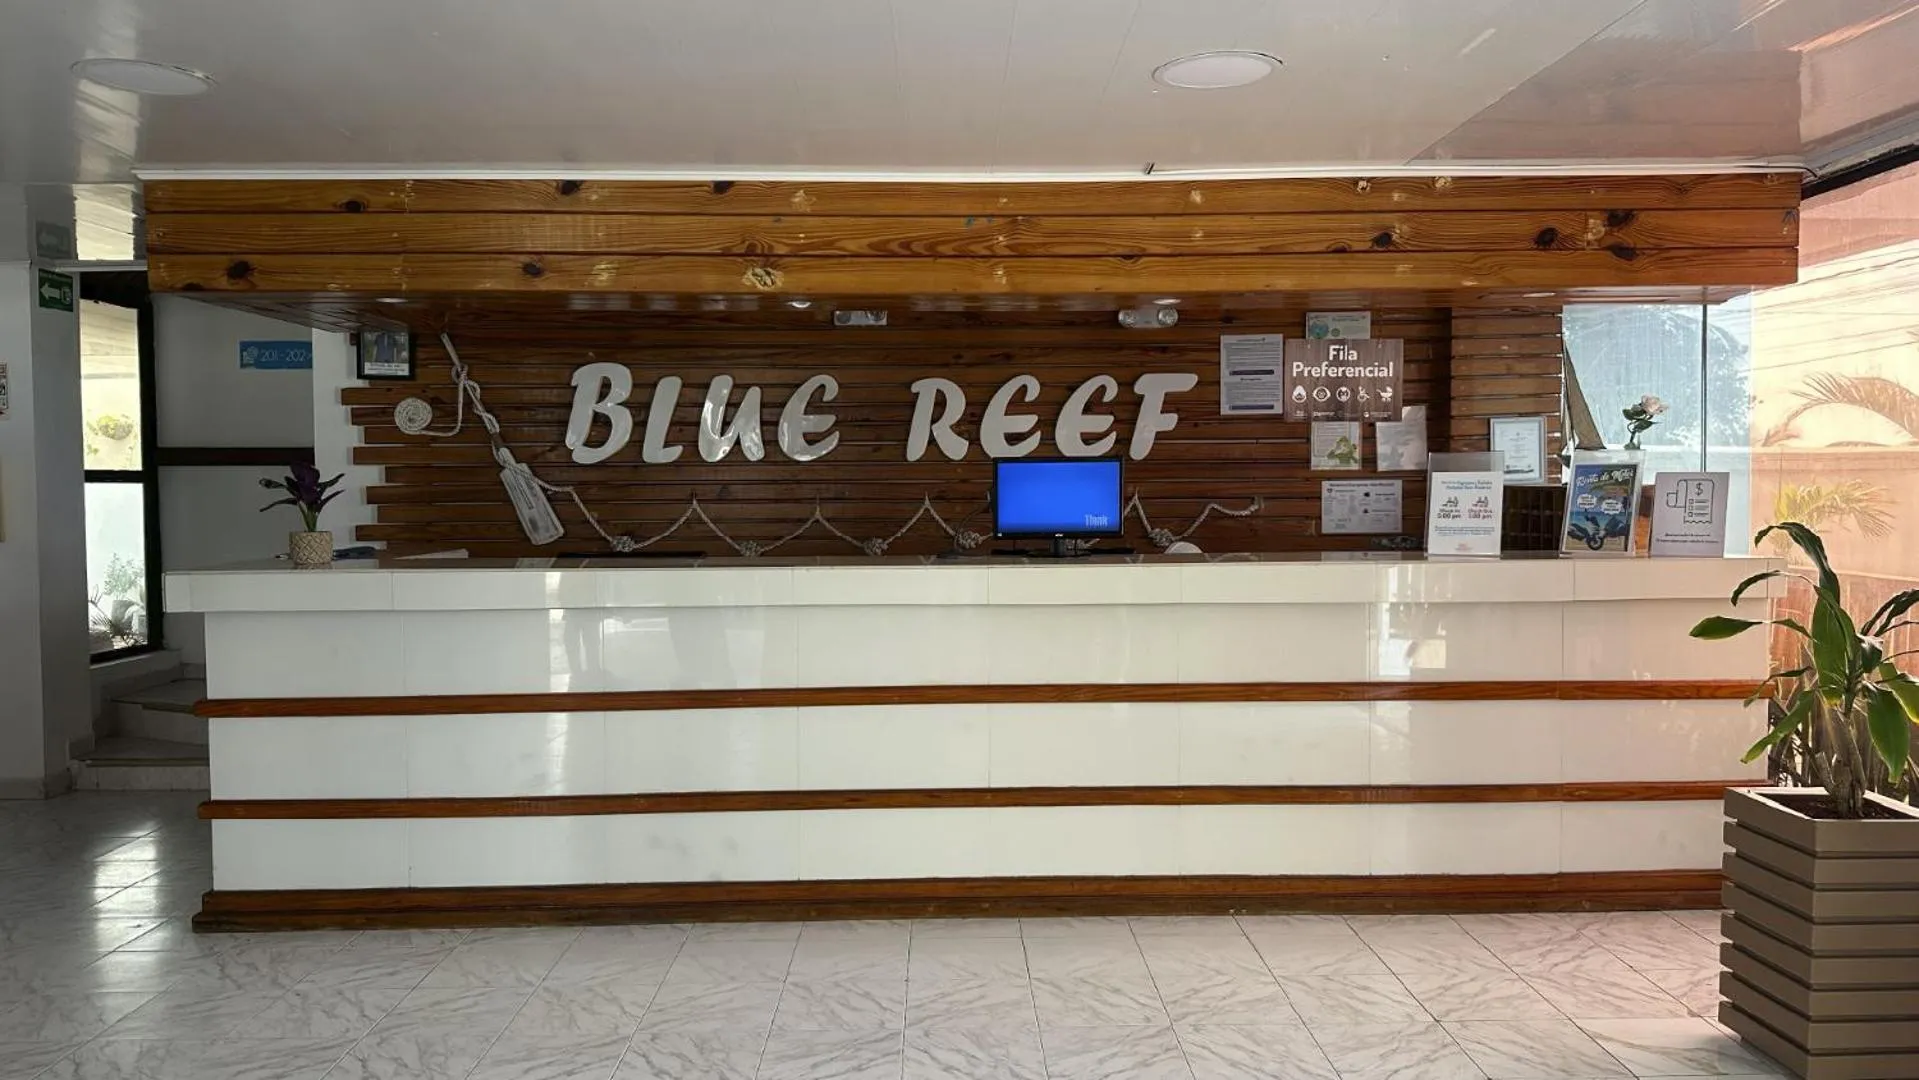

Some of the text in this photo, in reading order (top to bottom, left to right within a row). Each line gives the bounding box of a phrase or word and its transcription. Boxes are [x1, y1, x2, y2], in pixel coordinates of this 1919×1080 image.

[1329, 345, 1358, 361] Fila
[1292, 361, 1394, 377] Preferencial
[565, 362, 1198, 464] BLUE REEF
